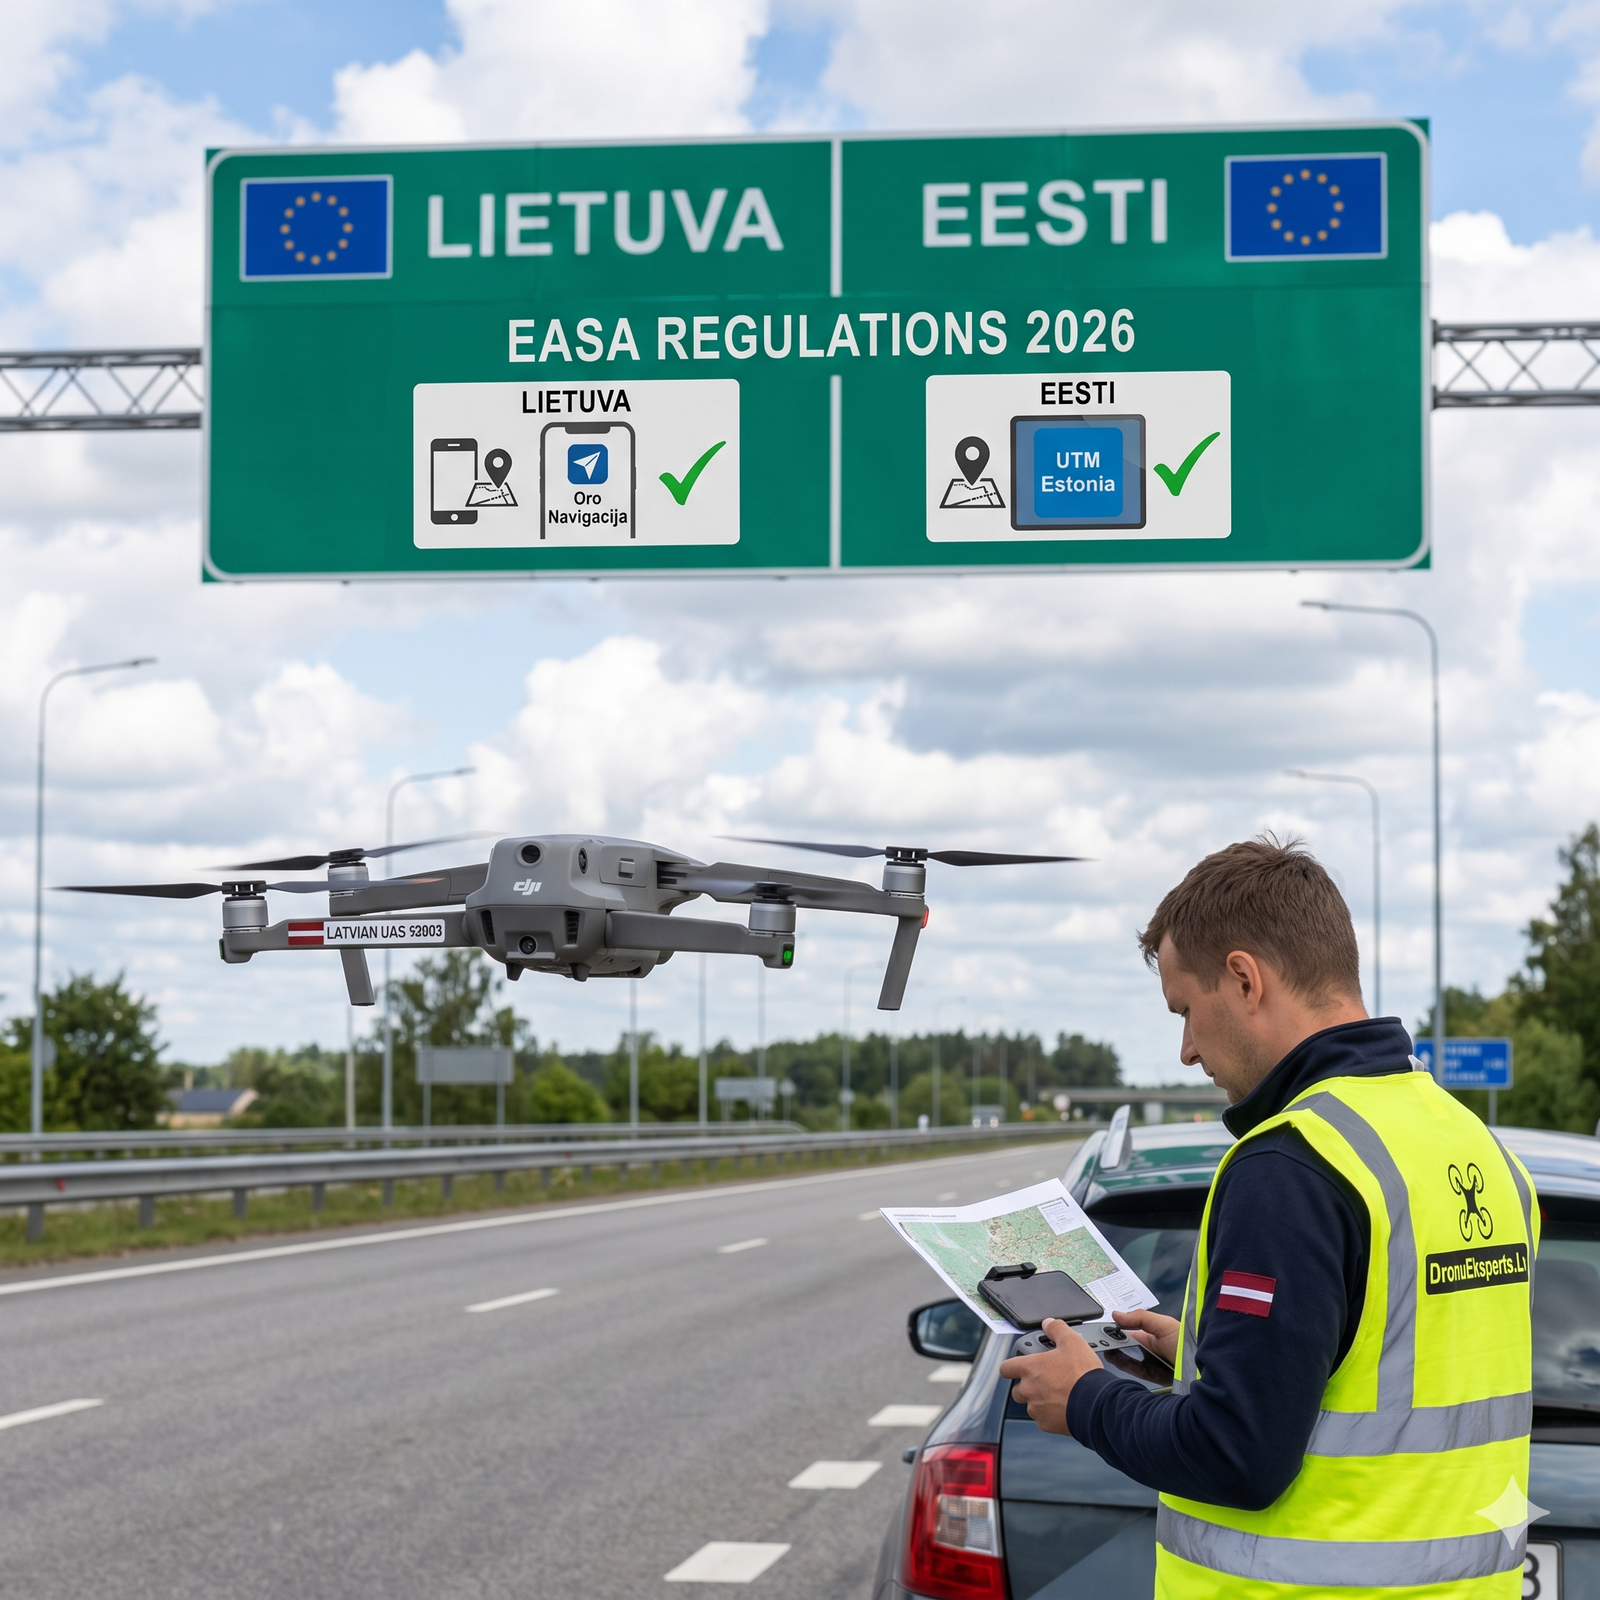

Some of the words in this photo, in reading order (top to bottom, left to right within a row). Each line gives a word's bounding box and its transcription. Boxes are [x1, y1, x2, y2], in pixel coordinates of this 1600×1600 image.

[427, 187, 784, 259] LIETUVA
[922, 178, 1168, 248] EESTI
[508, 317, 641, 363] EASA
[657, 310, 1008, 360] REGULATIONS
[1025, 308, 1136, 354] 2026
[522, 389, 632, 414] LIETUVA
[1040, 381, 1115, 405] EESTI
[1056, 452, 1101, 469] UTM
[1041, 475, 1116, 493] Estonia
[573, 491, 602, 506] Oro
[548, 508, 628, 528] Navigacija
[326, 925, 378, 940] LATVIAN
[381, 925, 406, 939] UAS
